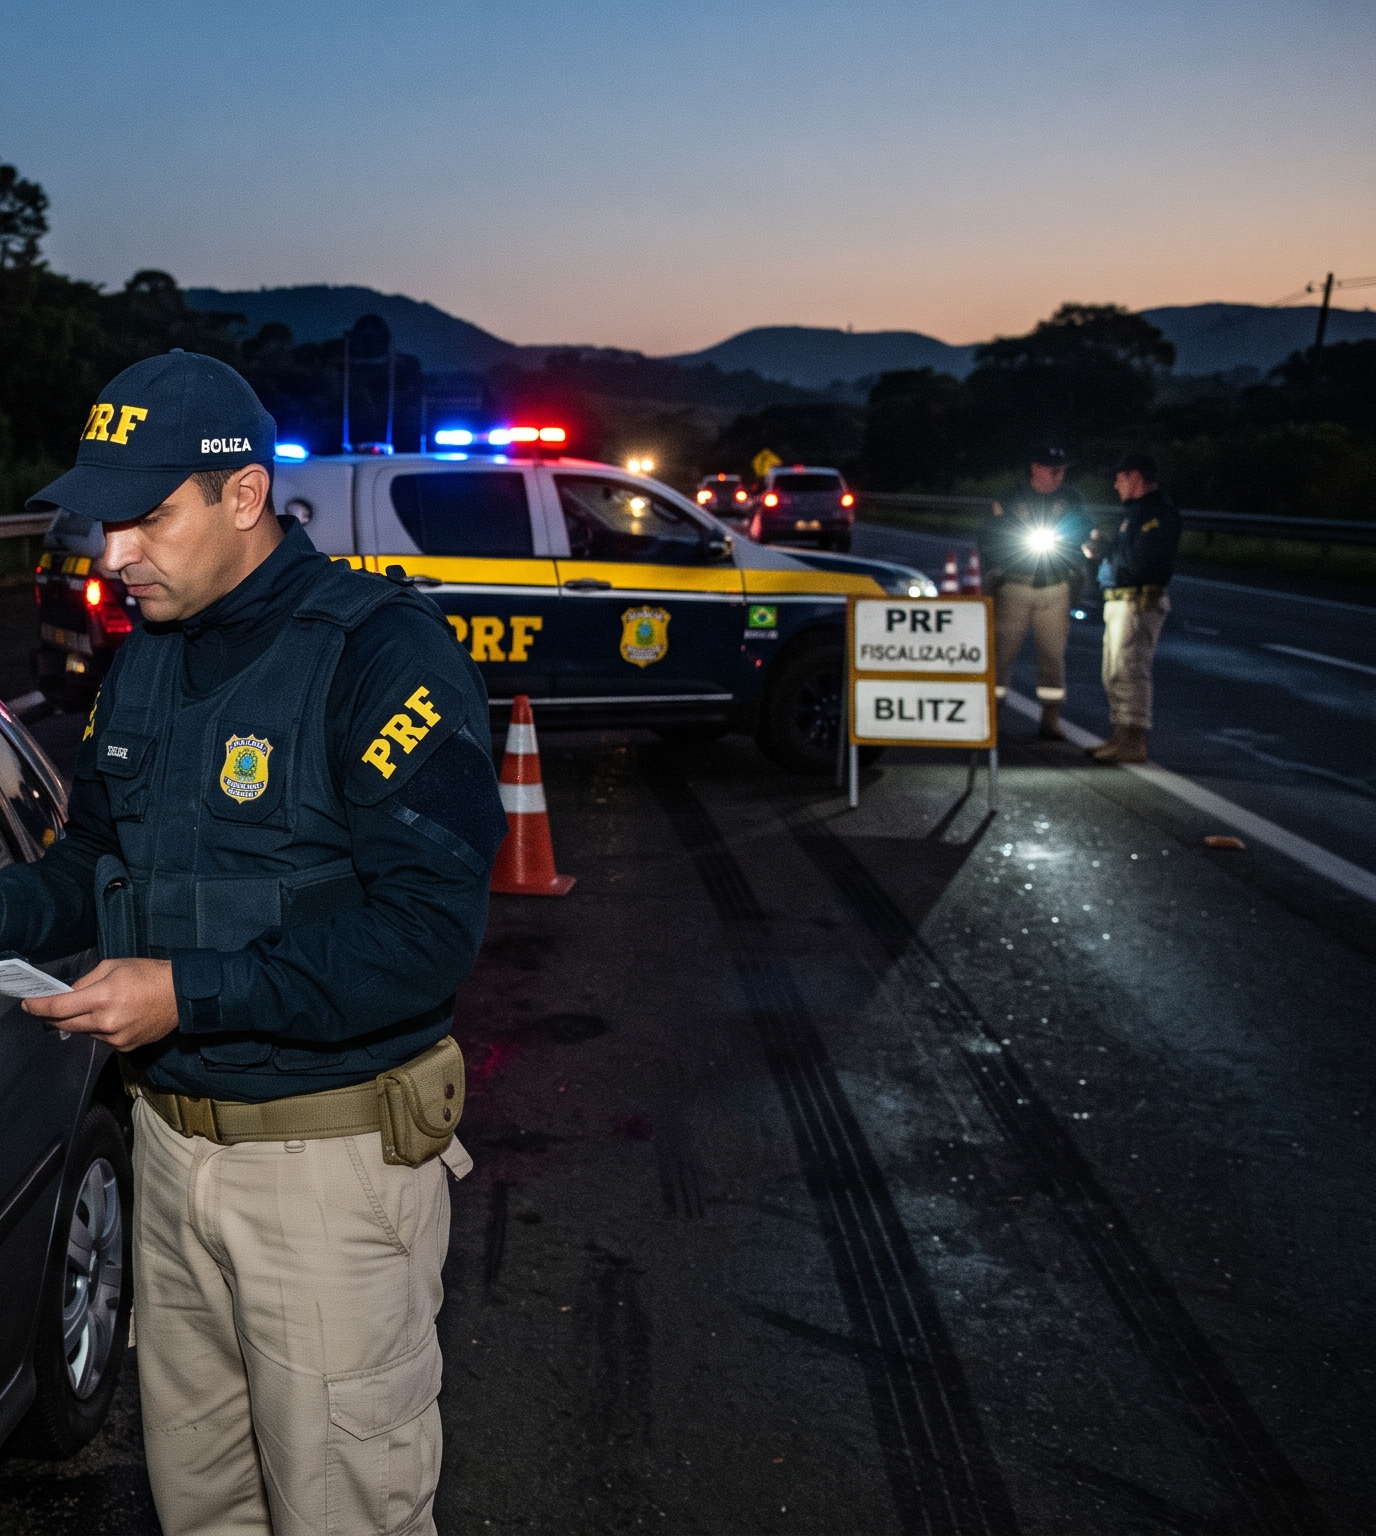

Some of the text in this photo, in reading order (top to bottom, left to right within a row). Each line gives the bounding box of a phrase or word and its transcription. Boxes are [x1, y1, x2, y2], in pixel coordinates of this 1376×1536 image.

[80, 403, 149, 445] RF
[885, 609, 953, 633] PRF
[860, 643, 982, 666] FISCALIZAÇÃO
[874, 697, 966, 724] BLITZ
[360, 684, 442, 780] PRF
